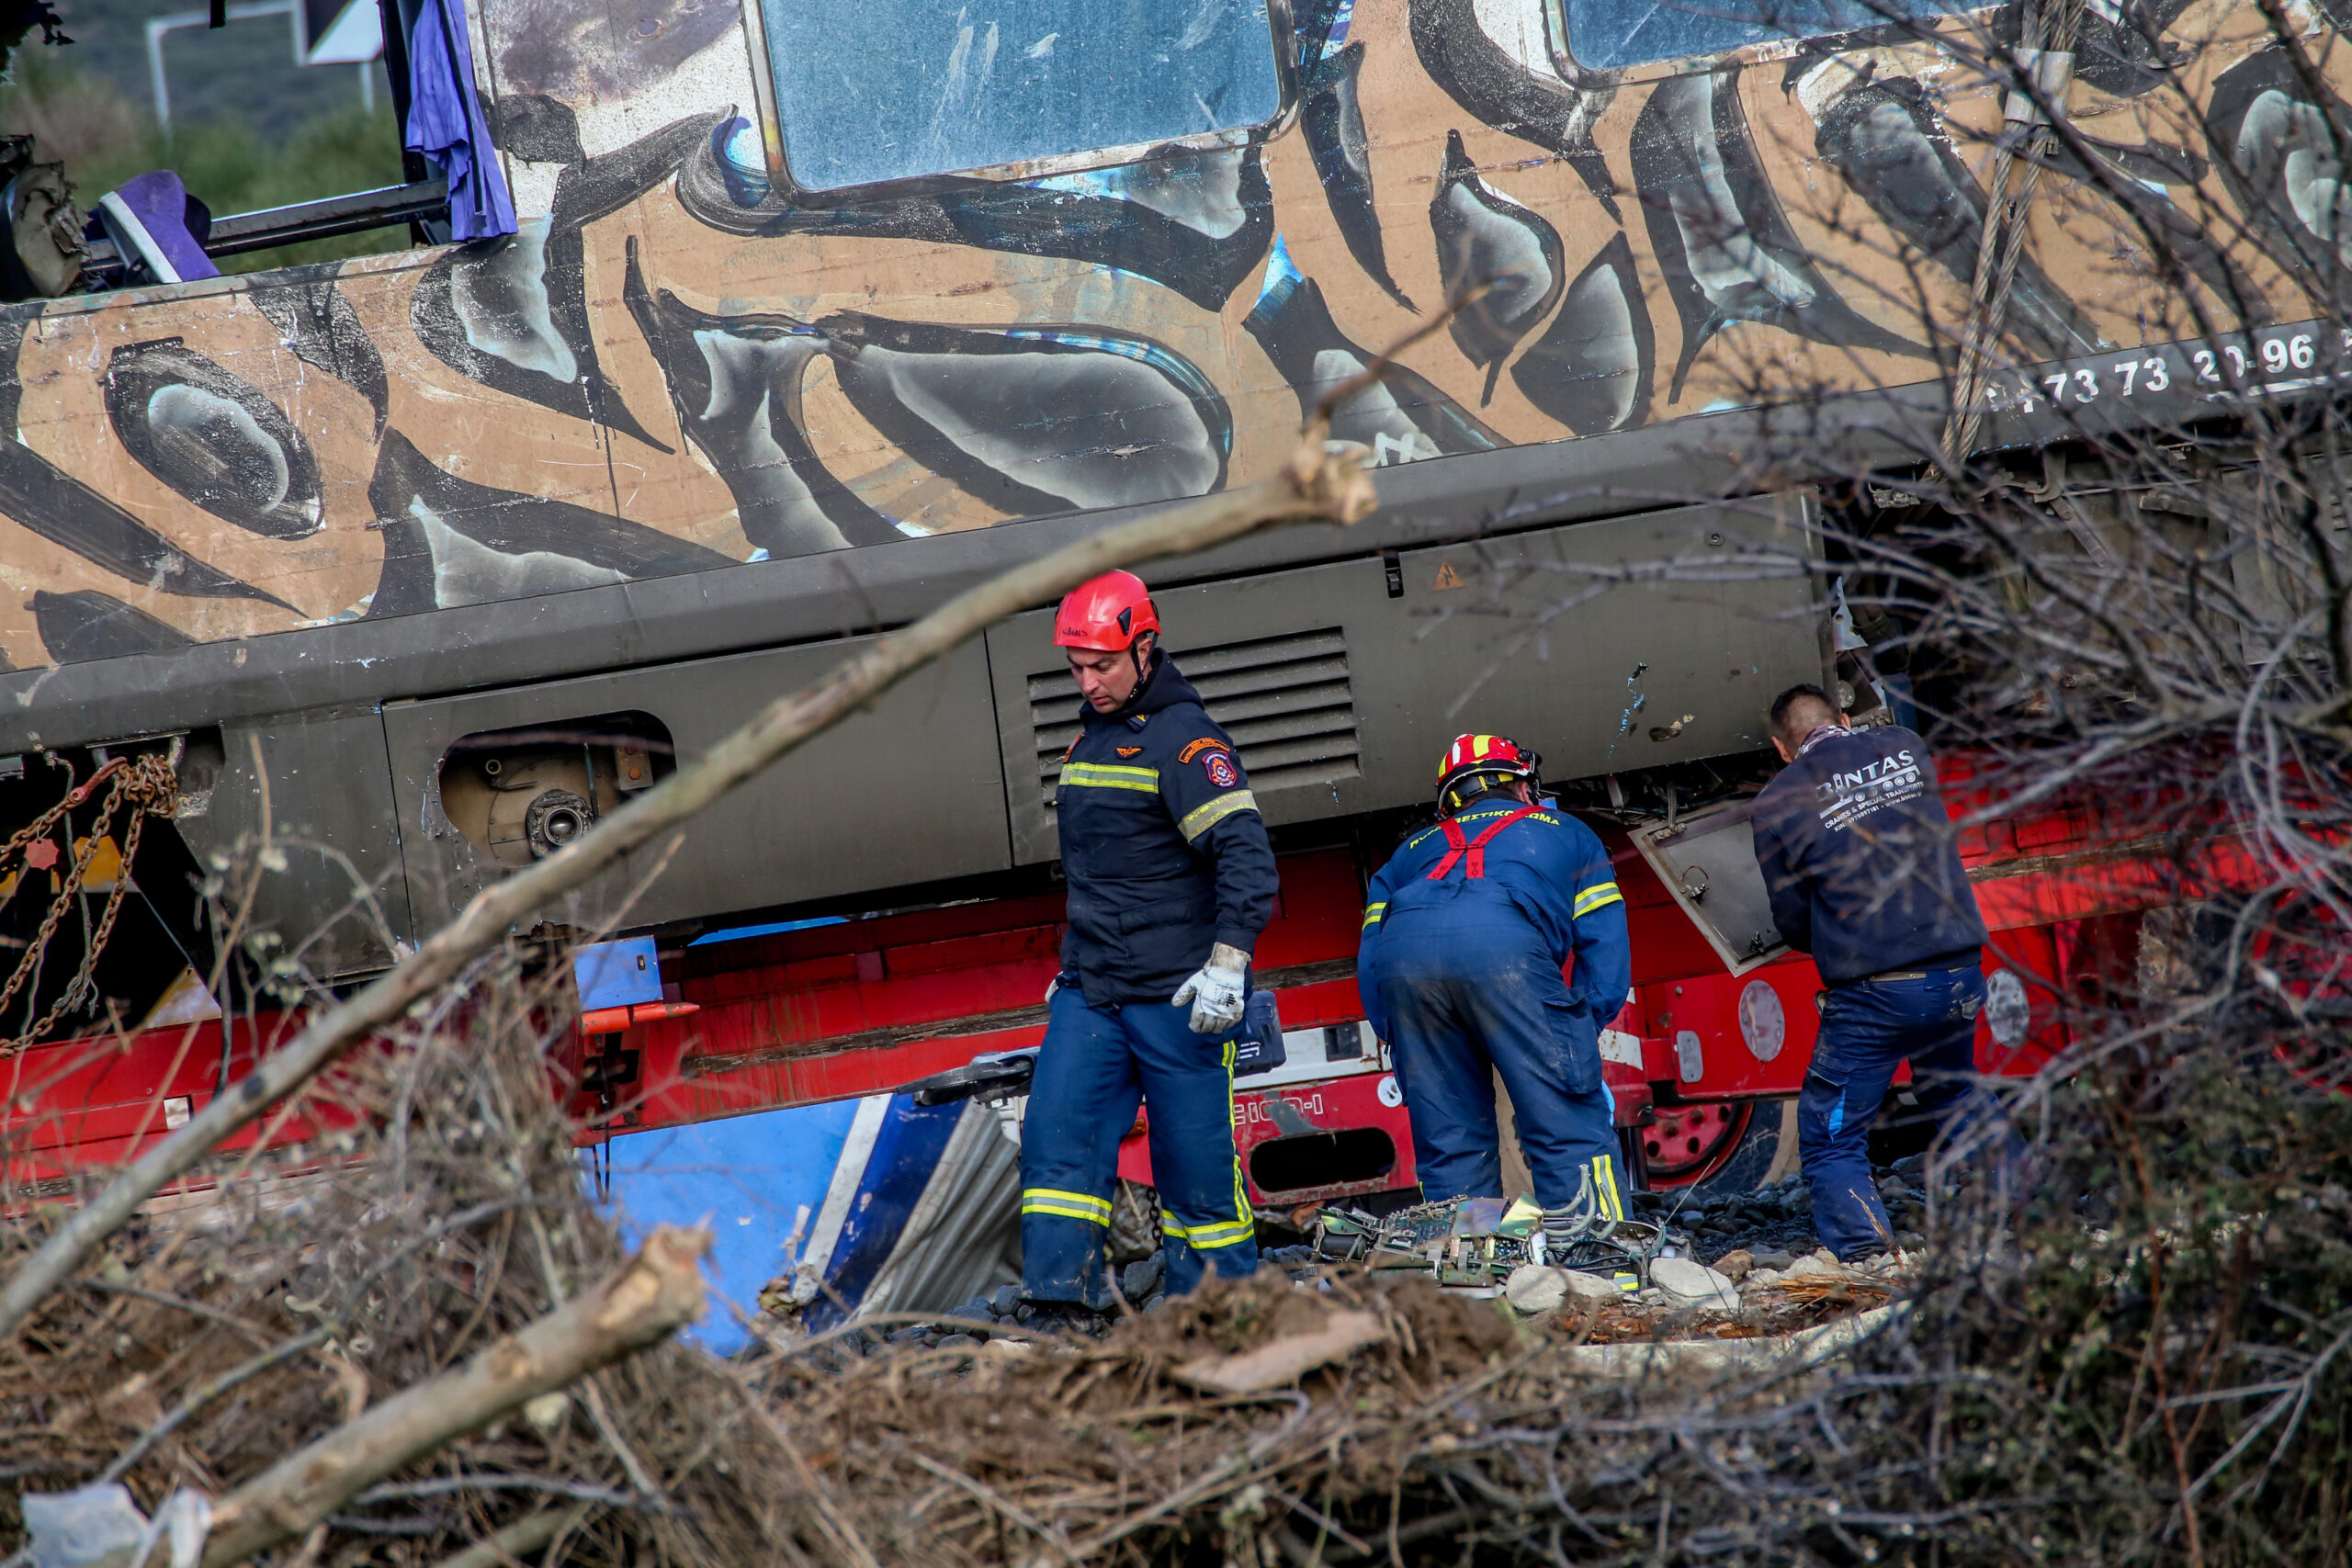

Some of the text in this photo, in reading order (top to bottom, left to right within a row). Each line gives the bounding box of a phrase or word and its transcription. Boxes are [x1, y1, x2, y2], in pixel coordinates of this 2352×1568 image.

[2115, 356, 2171, 397] 73
[1409, 809, 1515, 850] ΠΥΡΟΒΕΣΤΙΚΟ
[1525, 812, 1561, 827] ΩΜΑ
[1825, 809, 1851, 829] CRANES
[1858, 795, 1885, 810] SPECIAL
